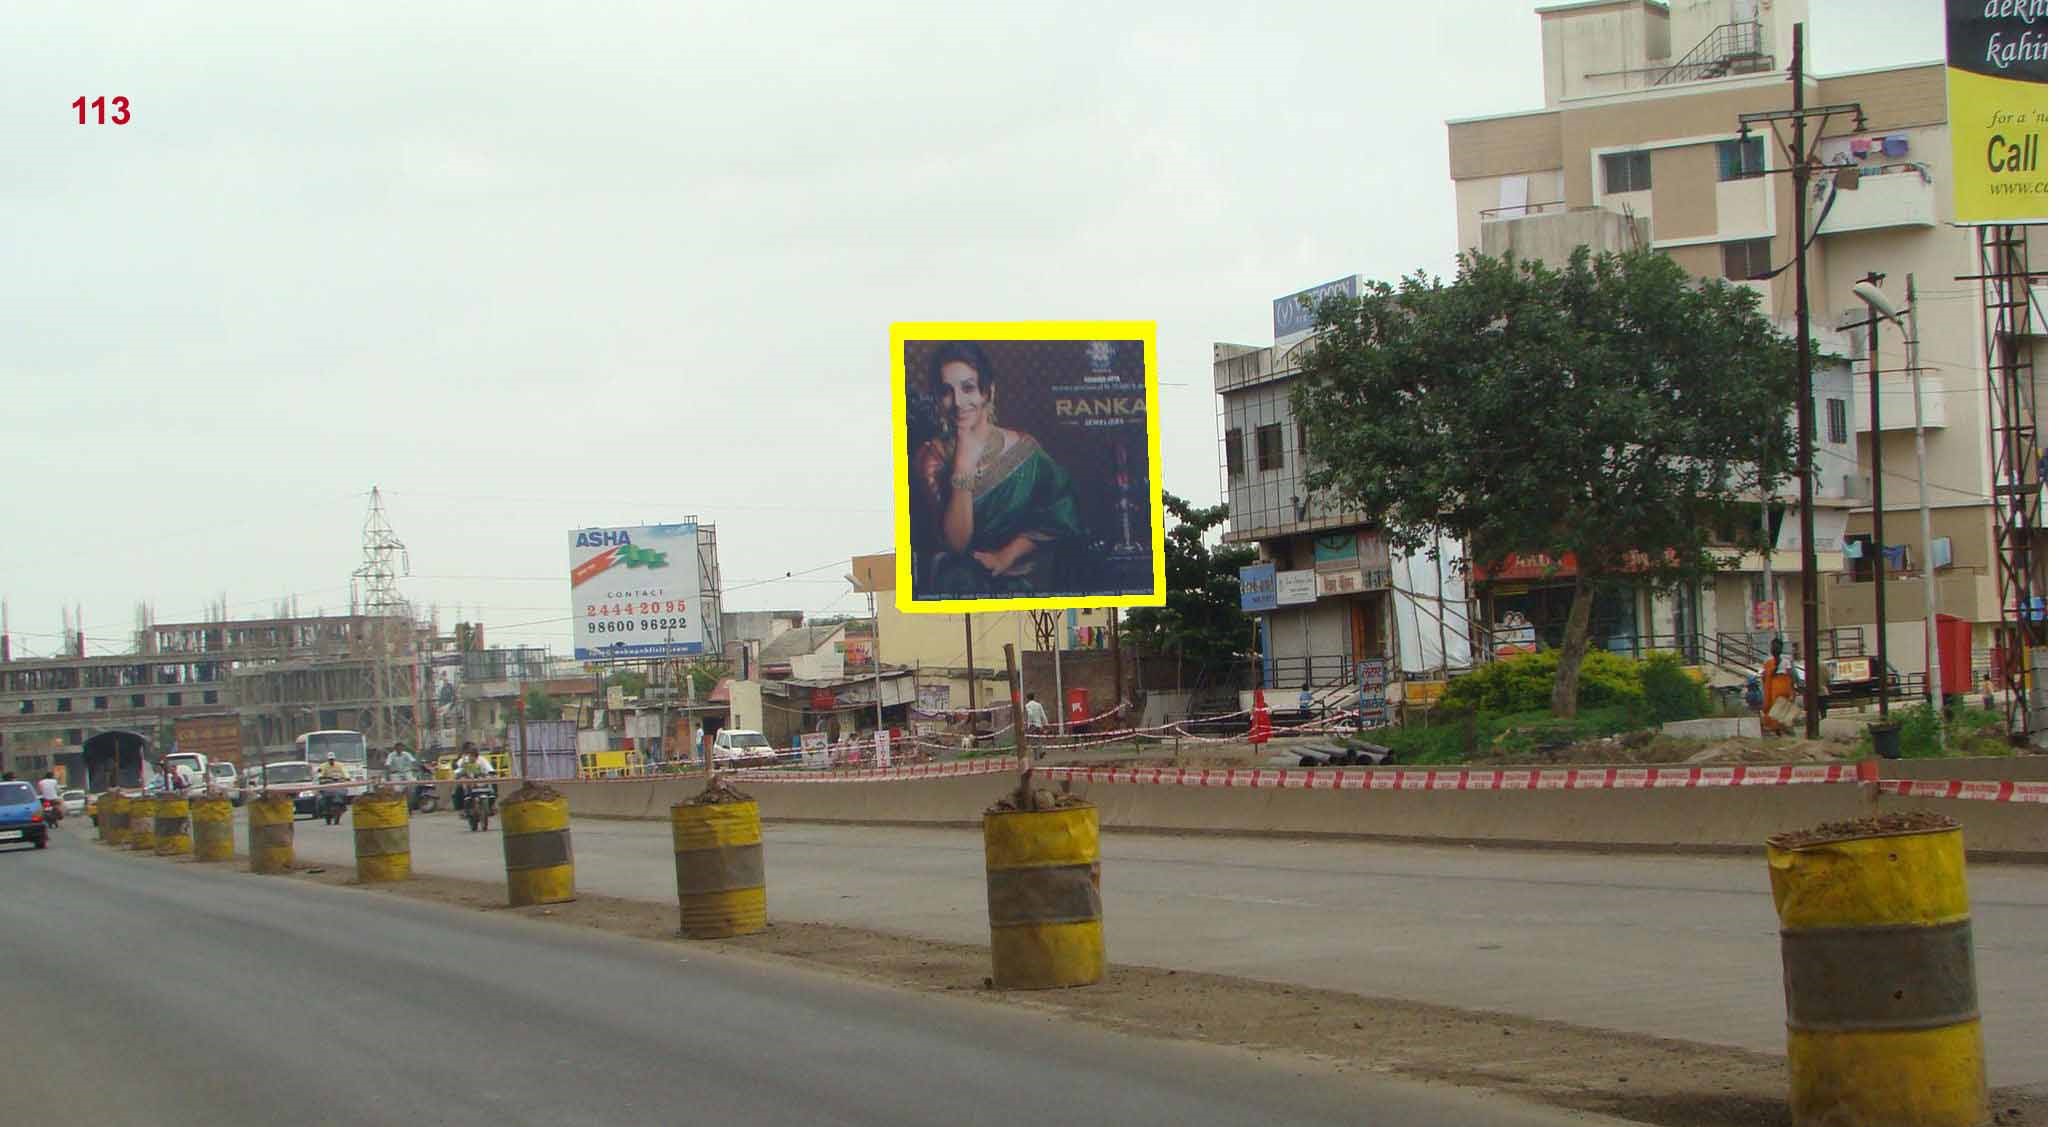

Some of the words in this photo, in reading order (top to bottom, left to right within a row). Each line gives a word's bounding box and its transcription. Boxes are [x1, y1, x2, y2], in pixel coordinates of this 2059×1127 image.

[1985, 0, 2048, 24] dekh
[1985, 109, 2015, 129] for
[2017, 113, 2025, 123] a
[1987, 134, 2039, 173] Call
[1055, 398, 1147, 416] RANKA
[575, 530, 632, 548] ASHA
[607, 589, 664, 599] CONTACT
[587, 602, 635, 617] 2444
[588, 620, 635, 634] 98600
[640, 618, 687, 631] 96222
